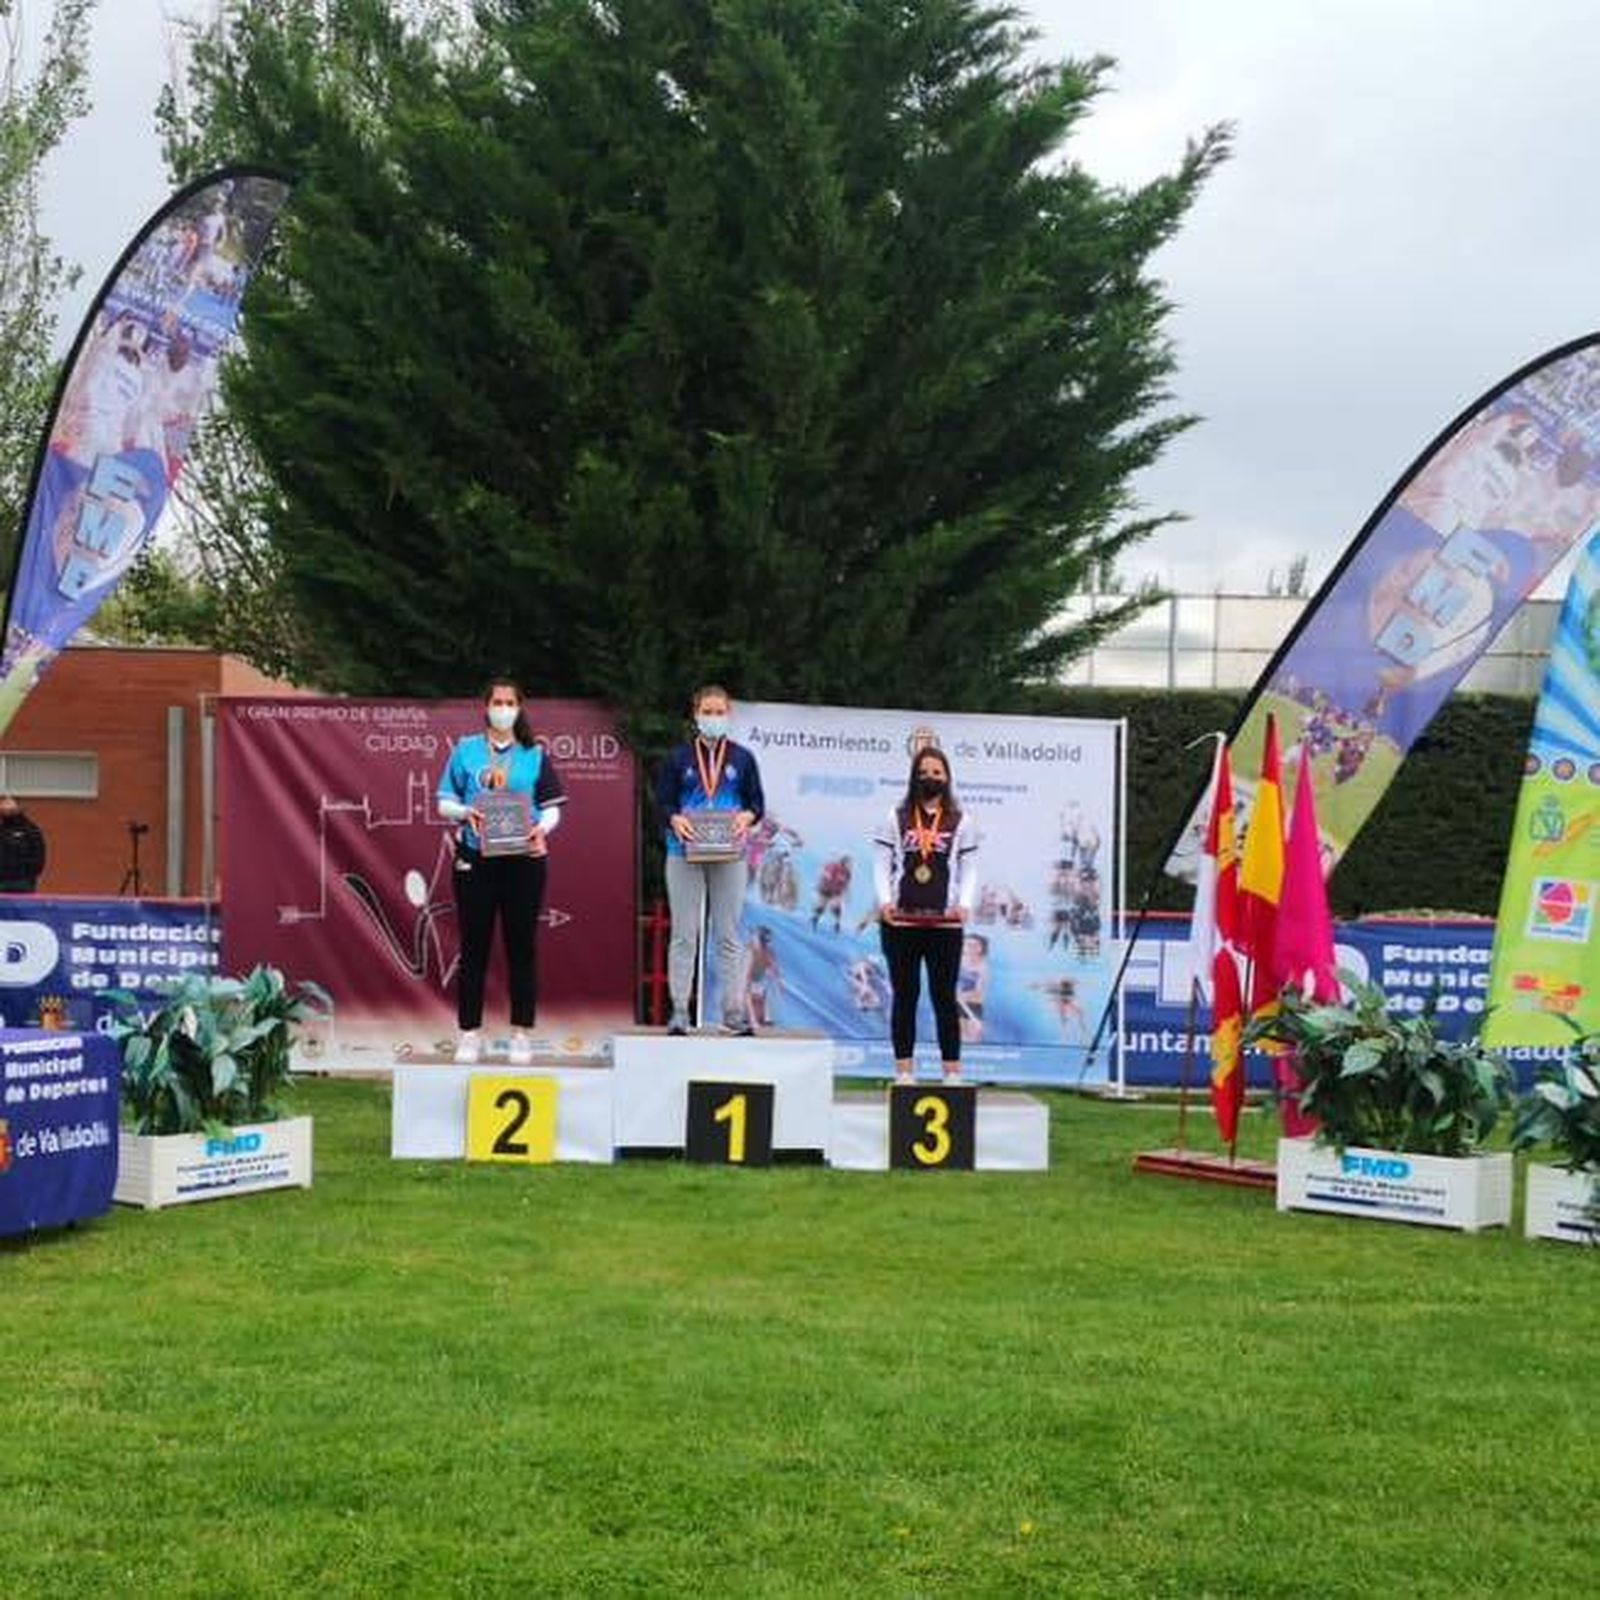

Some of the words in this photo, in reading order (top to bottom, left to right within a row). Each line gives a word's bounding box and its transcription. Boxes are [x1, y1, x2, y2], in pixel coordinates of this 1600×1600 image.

[748, 726, 893, 753] Ayuntamiento
[954, 740, 980, 762] de
[982, 741, 1083, 762] Valladolid
[1383, 944, 1491, 964] Funda
[71, 971, 109, 989] de
[1383, 968, 1490, 988] Munic
[1386, 993, 1425, 1013] de
[492, 1089, 531, 1155] 2
[714, 1094, 747, 1162] 1
[912, 1096, 950, 1164] 3
[16, 1131, 37, 1157] de
[1340, 1155, 1411, 1179] FMD
